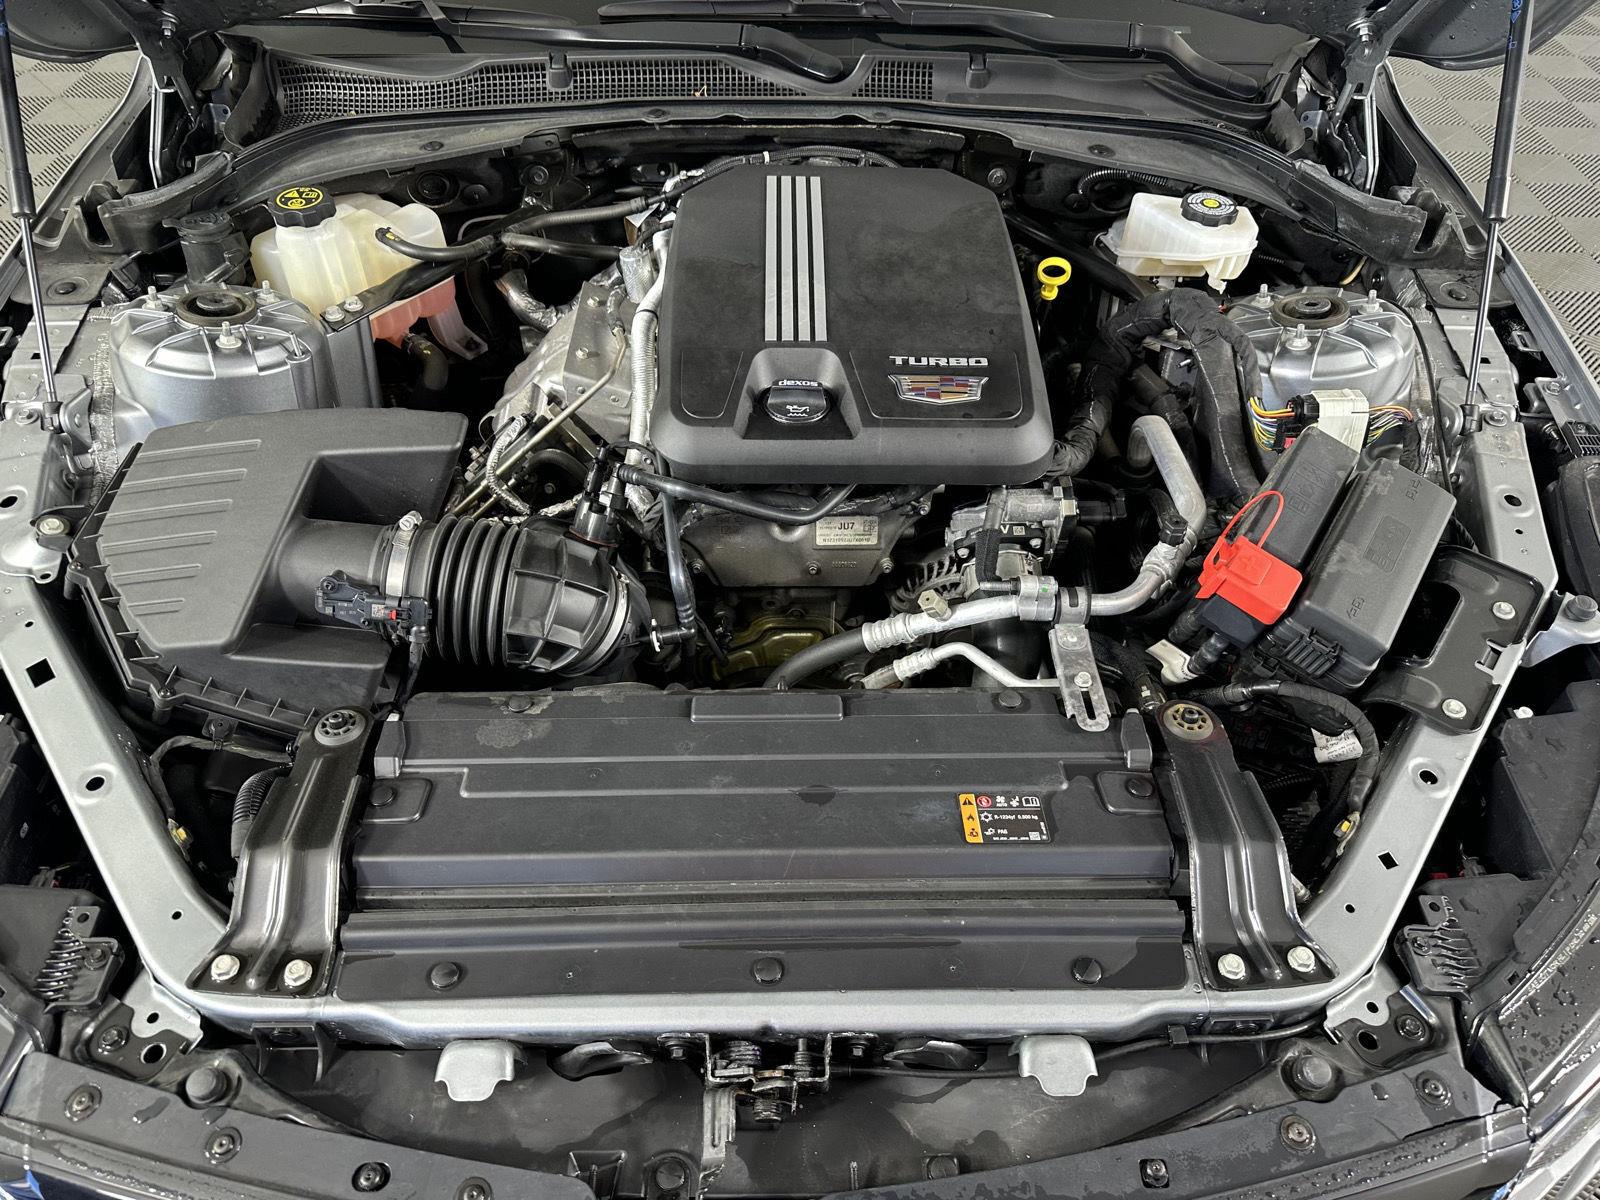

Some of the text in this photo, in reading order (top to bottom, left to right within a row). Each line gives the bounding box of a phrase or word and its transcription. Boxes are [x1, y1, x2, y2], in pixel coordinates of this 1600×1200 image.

[889, 355, 989, 367] TURBO
[778, 378, 818, 387] dexos
[837, 522, 855, 530] JU7
